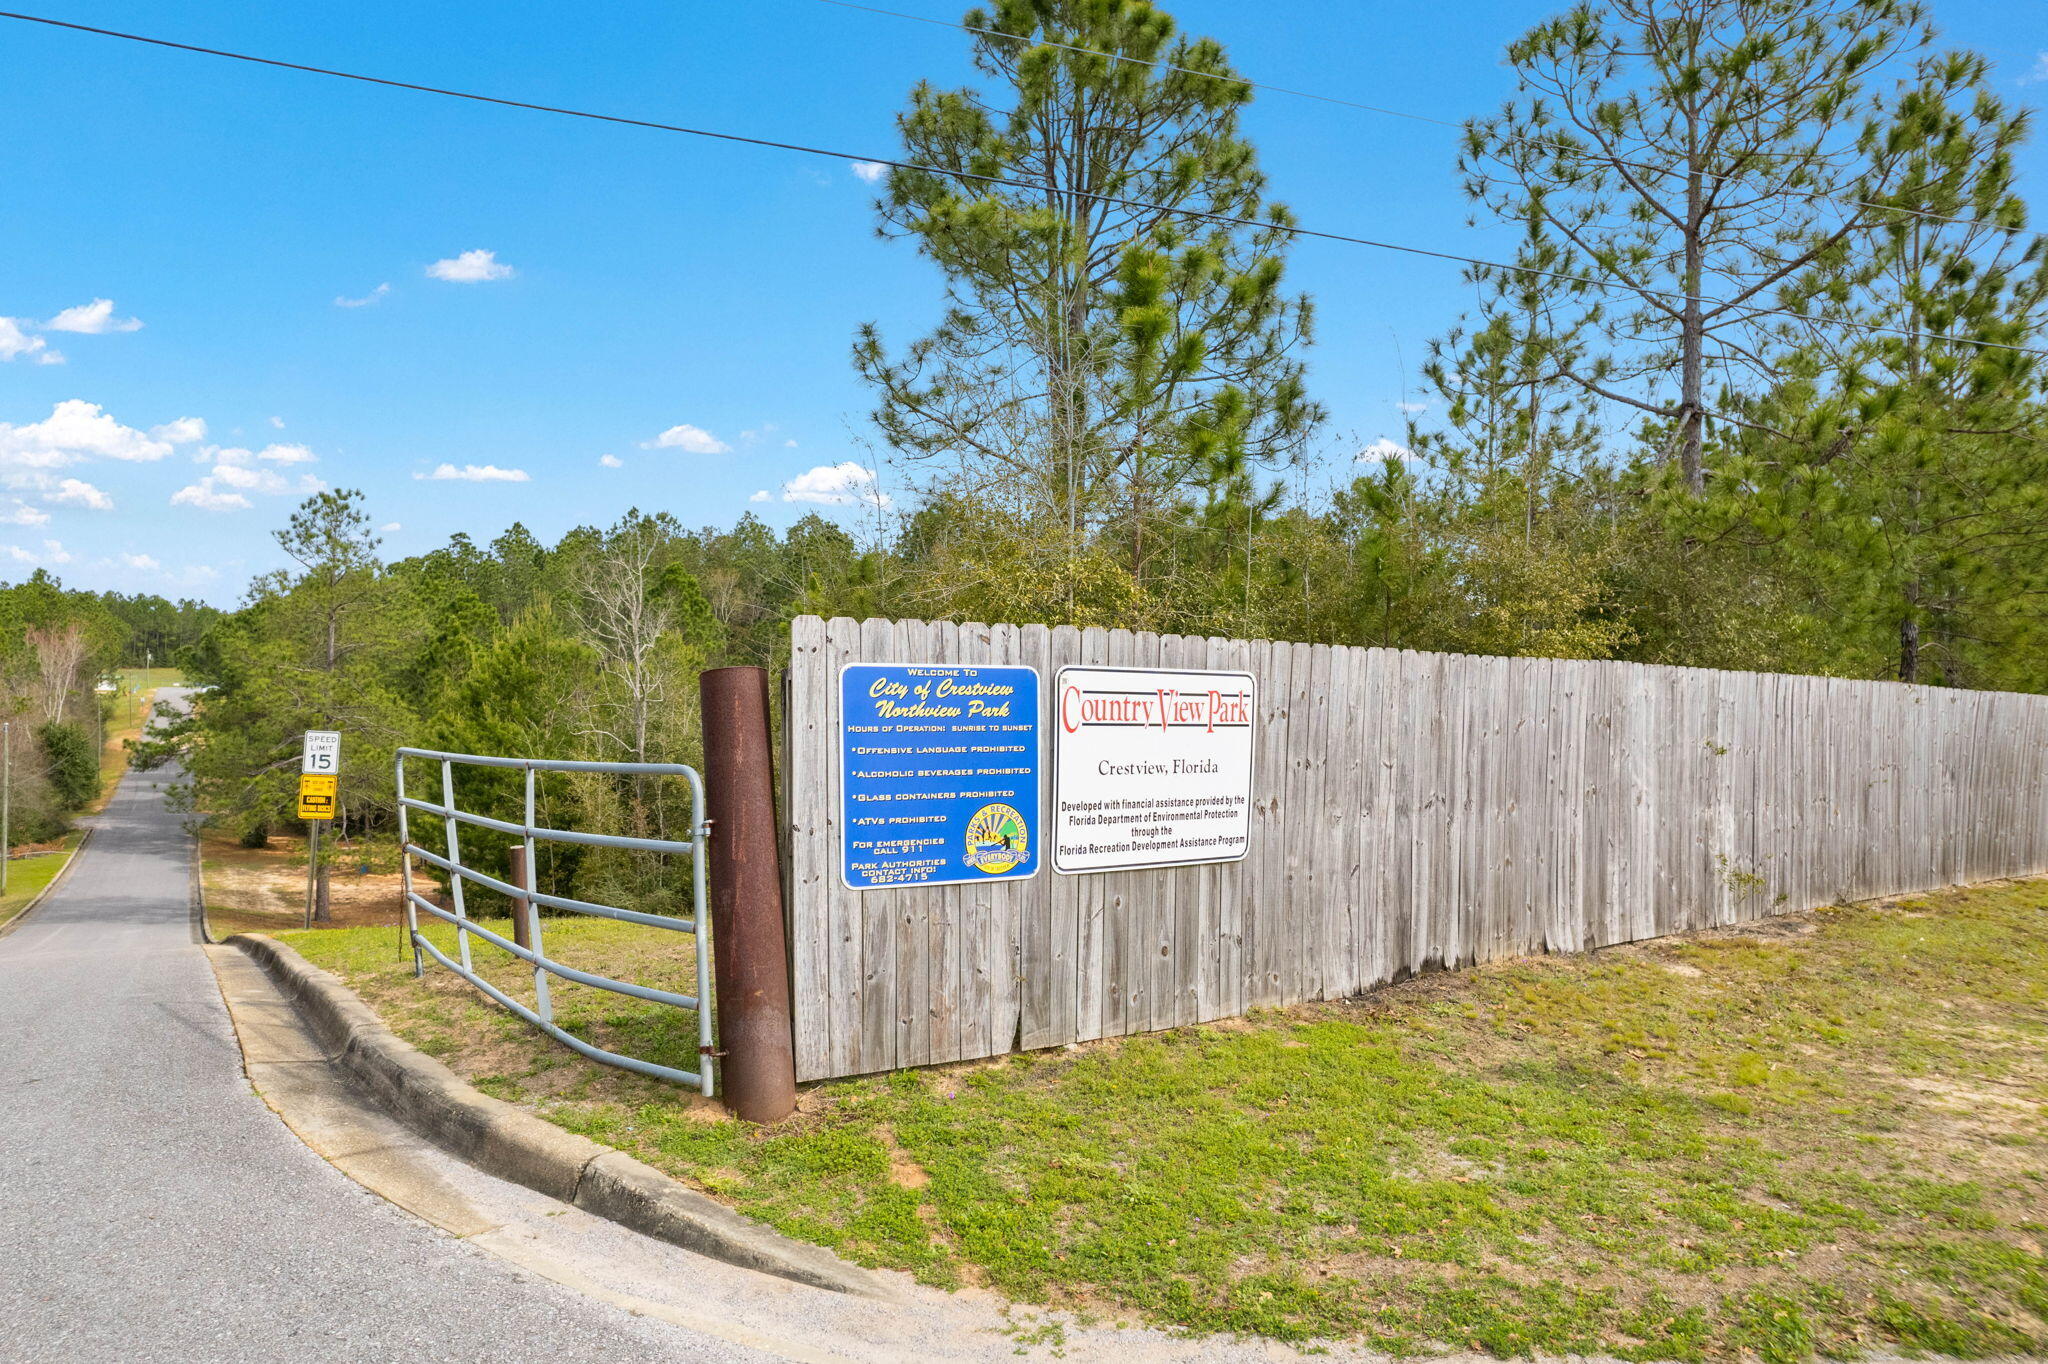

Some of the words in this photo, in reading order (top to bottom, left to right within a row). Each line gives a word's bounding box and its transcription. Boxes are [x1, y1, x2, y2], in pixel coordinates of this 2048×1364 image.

[908, 668, 960, 676] WELCOME
[963, 669, 978, 677] TO
[869, 678, 909, 698] City
[914, 680, 932, 700] of
[936, 678, 1013, 698] Crestview
[875, 700, 961, 718] Northview
[968, 700, 1010, 717] Park
[1063, 686, 1154, 733] Country
[1157, 689, 1205, 733] View
[1207, 690, 1249, 733] Park
[857, 746, 913, 754] OFFENSIVE
[311, 754, 330, 768] 15
[1099, 760, 1168, 776] Crestview,
[1173, 758, 1218, 774] Florida
[857, 769, 914, 778] ALCOHOLIC
[858, 794, 891, 802] GLASS
[960, 790, 1015, 798] PROHIBITED
[1062, 800, 1102, 812] Developed
[1104, 800, 1120, 809] with
[1122, 799, 1153, 809] financial
[1155, 798, 1194, 808] assistance
[1195, 796, 1224, 807] provided
[1225, 796, 1233, 805] by
[1234, 795, 1245, 804] the
[1069, 815, 1096, 826] Florida
[1098, 813, 1142, 826] Department
[1144, 812, 1151, 822] of
[1153, 811, 1202, 822] Environmental
[1205, 809, 1238, 819] Protection
[968, 817, 980, 846] PARKS
[990, 806, 1025, 843] RECREATION
[1131, 827, 1159, 838] through
[1161, 827, 1172, 836] the
[853, 841, 874, 849] FOR
[876, 838, 945, 847] EMERGENCIES
[1060, 845, 1087, 856] Florida
[1089, 843, 1130, 854] Recreation
[1132, 840, 1178, 851] Development
[1179, 837, 1217, 847] Assistance
[1218, 836, 1245, 846] Program
[851, 863, 878, 871] PARK
[881, 859, 946, 869] AUTHORITIES
[862, 868, 907, 877] CONTACT
[871, 873, 928, 884] 682-4715
